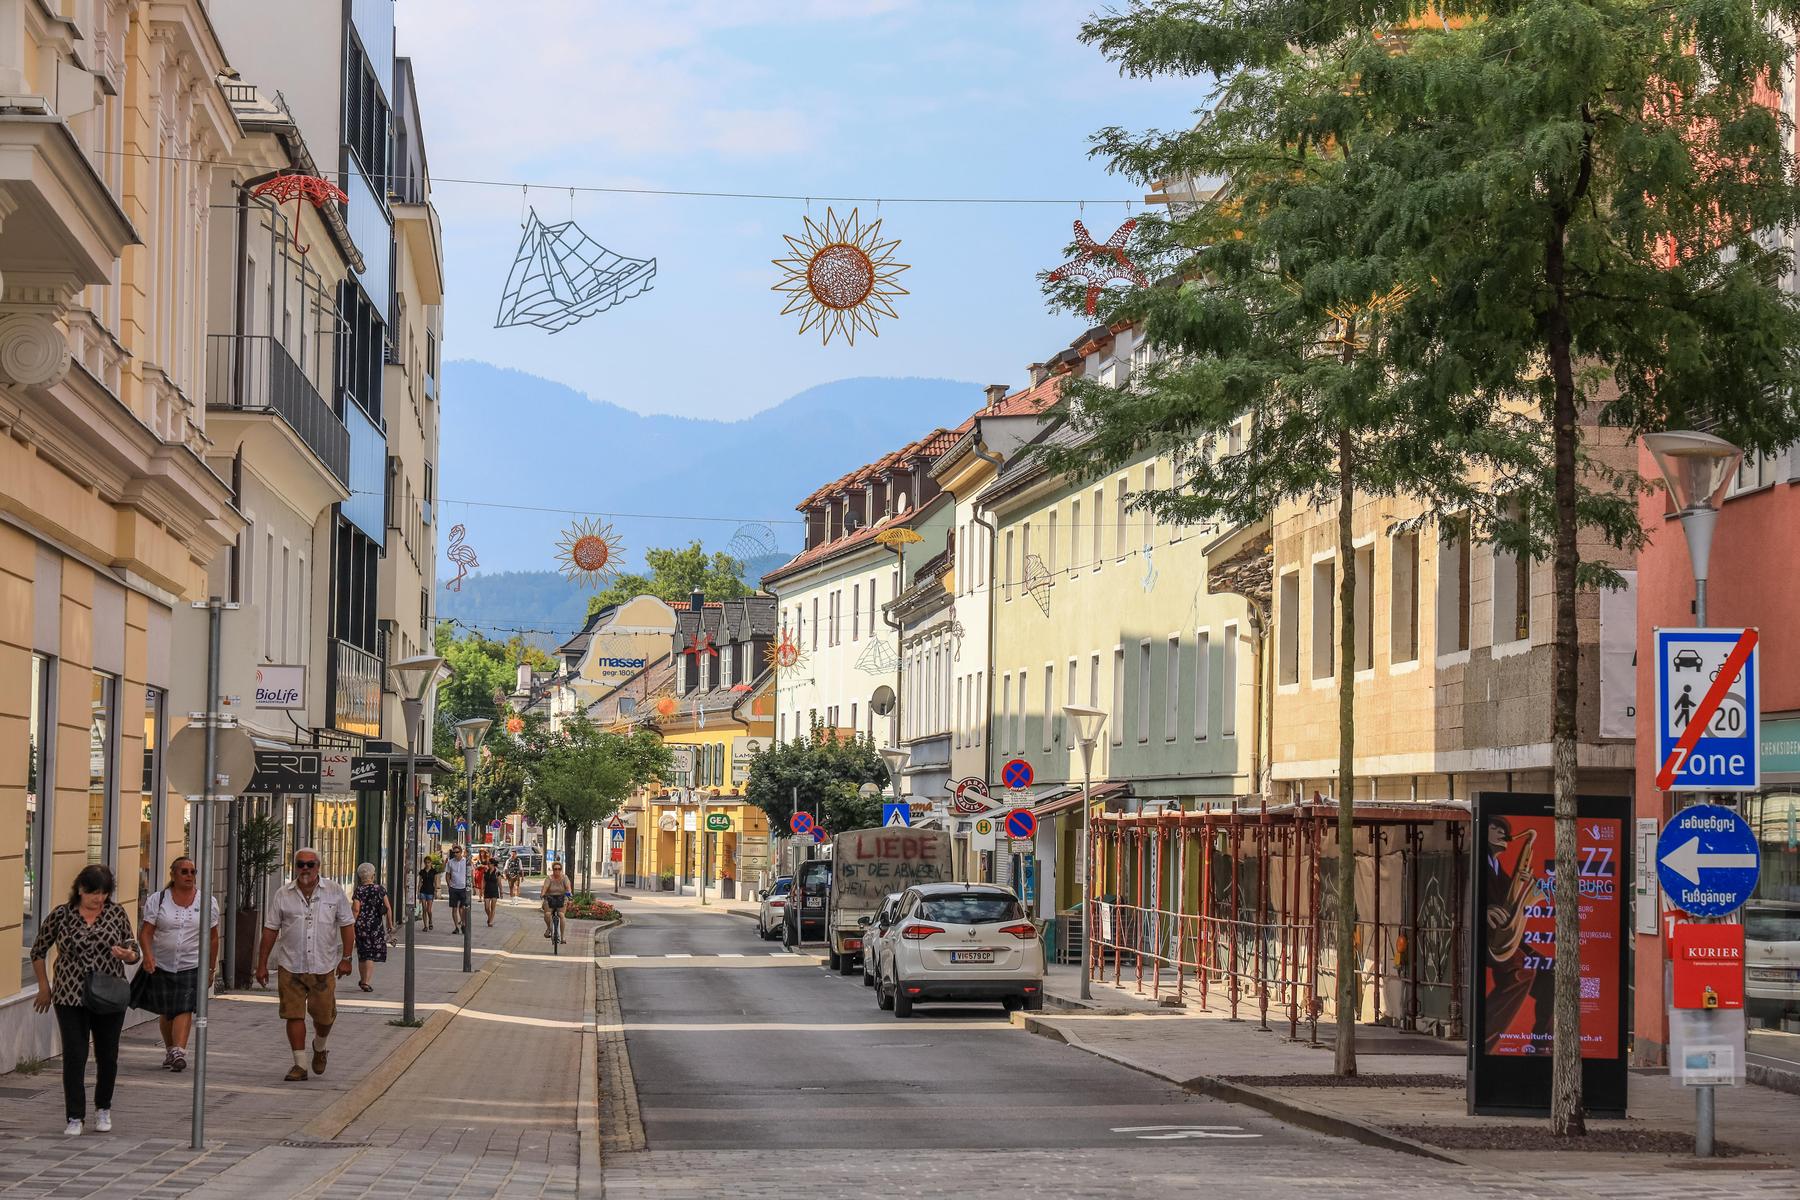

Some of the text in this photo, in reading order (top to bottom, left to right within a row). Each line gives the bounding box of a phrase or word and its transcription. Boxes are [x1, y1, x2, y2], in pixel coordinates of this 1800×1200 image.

[599, 657, 646, 668] masser
[256, 688, 299, 704] BioLife
[1626, 706, 1636, 717] D
[1714, 707, 1741, 731] 20
[1671, 748, 1745, 776] Zone
[962, 780, 987, 794] TABAK
[910, 802, 933, 811] oma
[957, 791, 980, 810] TRAFIK
[709, 816, 729, 825] GEA
[980, 822, 988, 832] H
[1679, 815, 1735, 833] Fußgänger
[857, 834, 938, 859] LIEBE
[842, 862, 864, 877] IST
[868, 863, 889, 877] DIE
[1682, 888, 1737, 906] Fußgänger
[1688, 947, 1740, 957] KURIER
